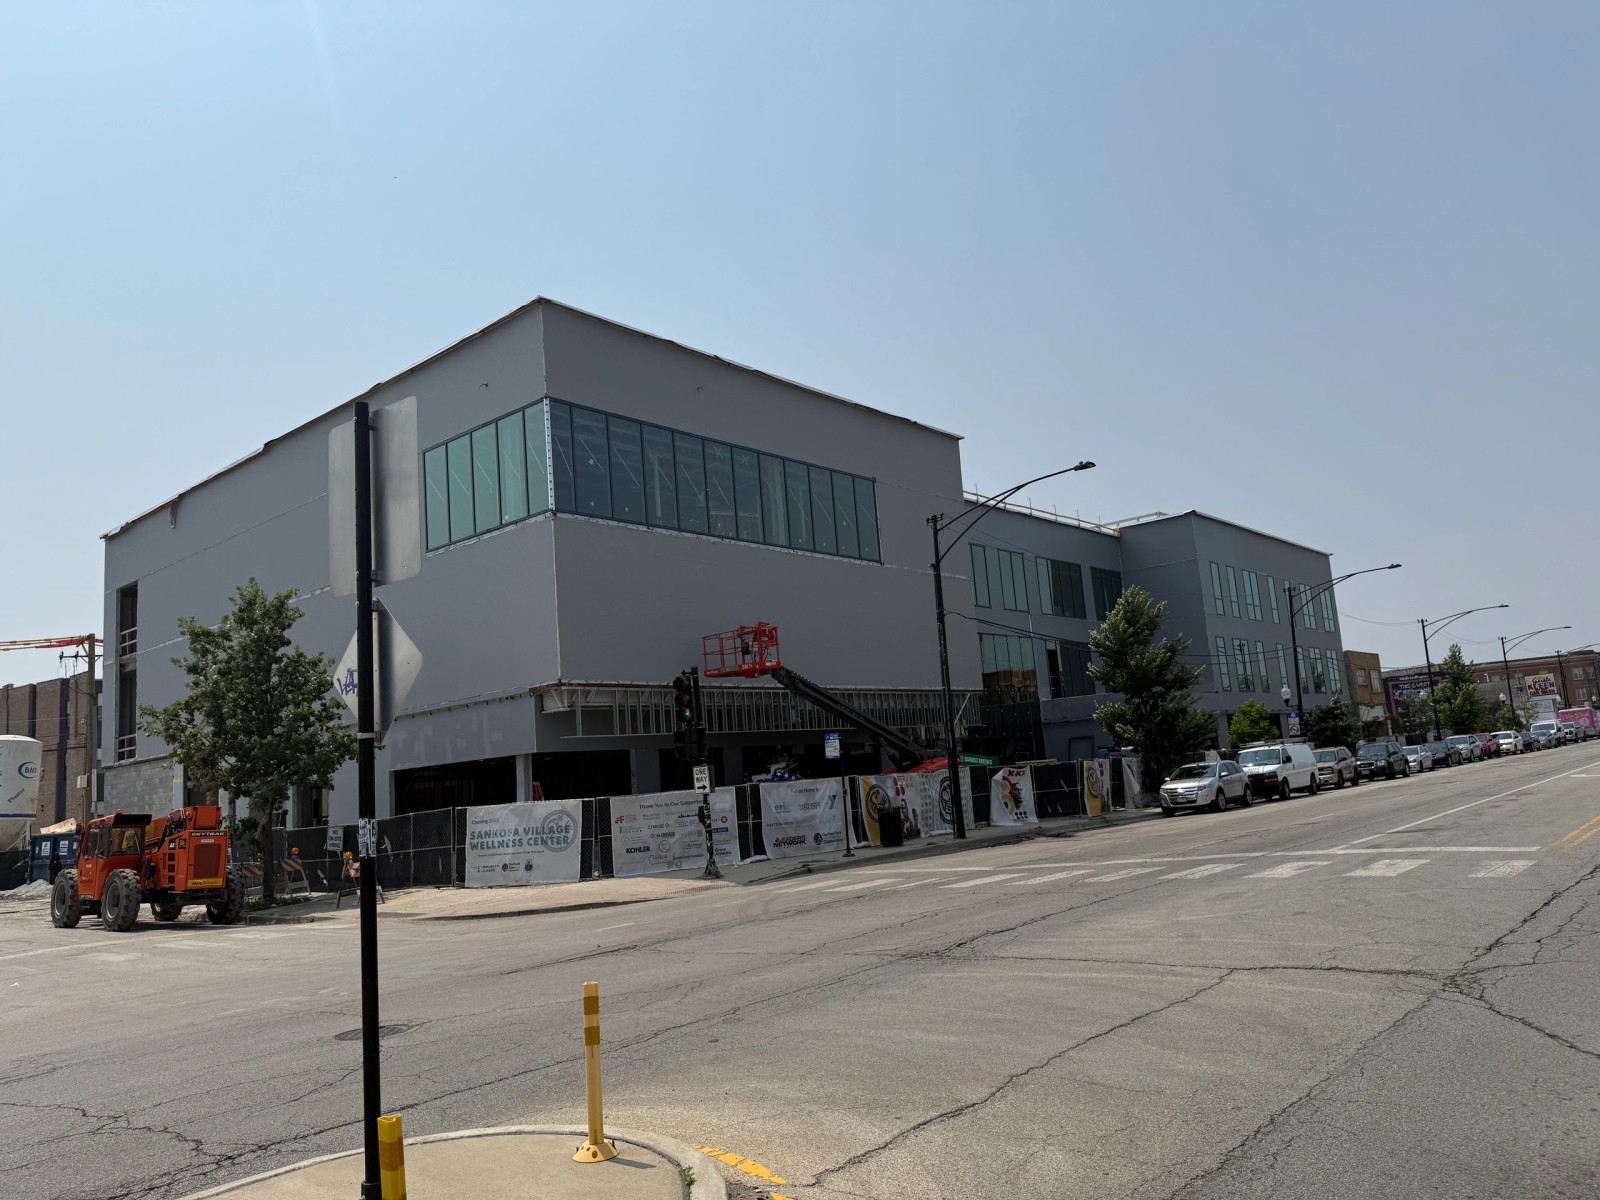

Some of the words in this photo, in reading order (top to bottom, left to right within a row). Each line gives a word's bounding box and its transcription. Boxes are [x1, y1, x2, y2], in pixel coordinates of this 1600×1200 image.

[694, 768, 706, 776] ONE
[7, 788, 25, 803] Plaster
[804, 802, 820, 810] RUSH
[470, 828, 520, 840] SANKOFA
[524, 825, 570, 836] VILLAGE
[470, 838, 523, 850] WELLNESS
[527, 836, 570, 846] CENTER
